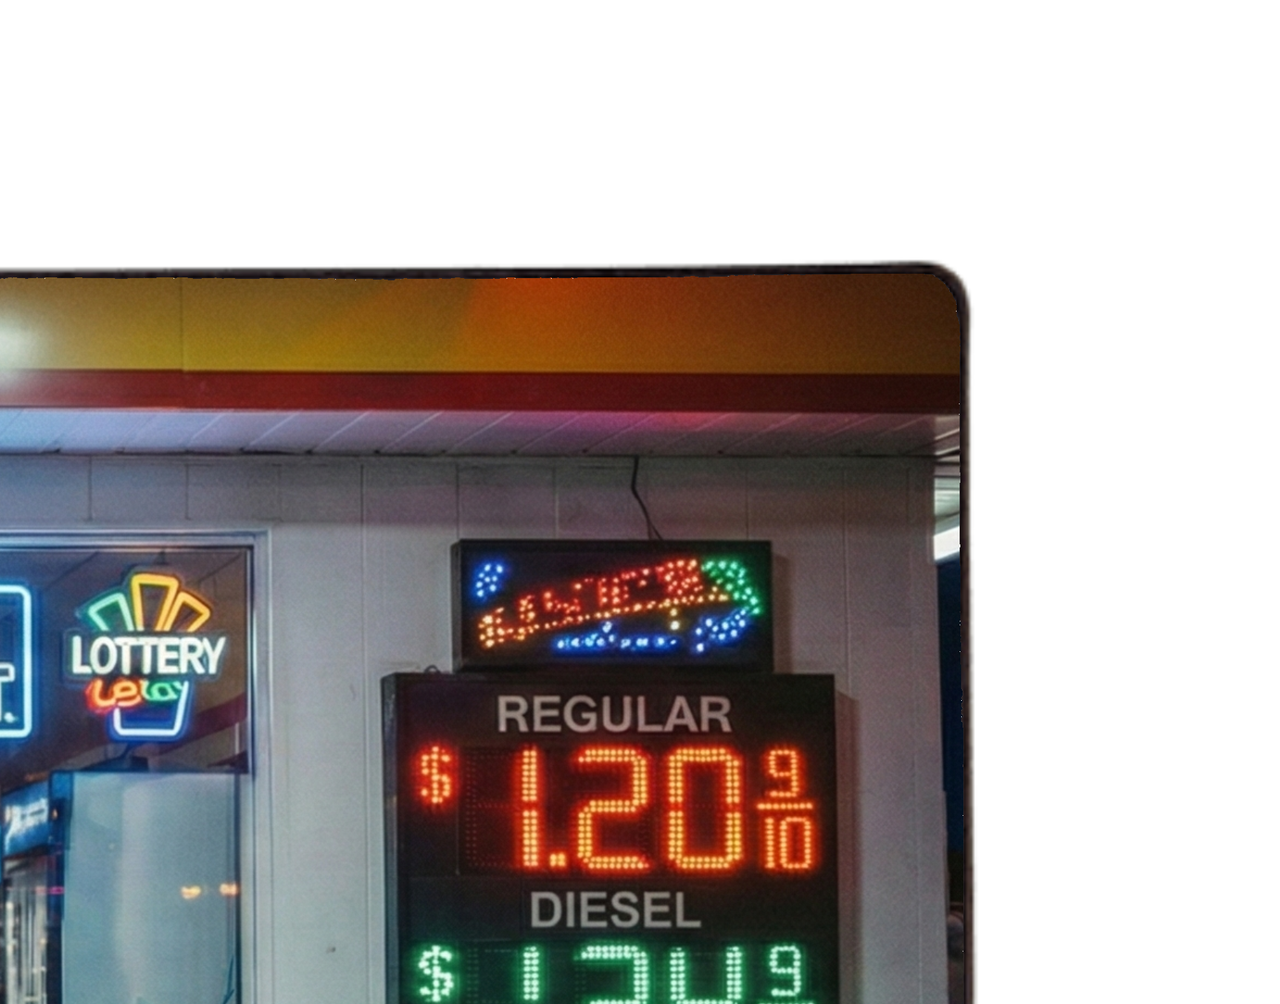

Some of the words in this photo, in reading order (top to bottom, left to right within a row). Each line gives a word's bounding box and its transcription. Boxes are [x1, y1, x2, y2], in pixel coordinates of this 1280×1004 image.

[72, 635, 227, 675] LOTTERY
[497, 696, 732, 732] REGULAR
[421, 746, 452, 803] $
[522, 749, 742, 868] 1.20
[531, 891, 702, 928] DIESEL
[419, 945, 454, 1002] $
